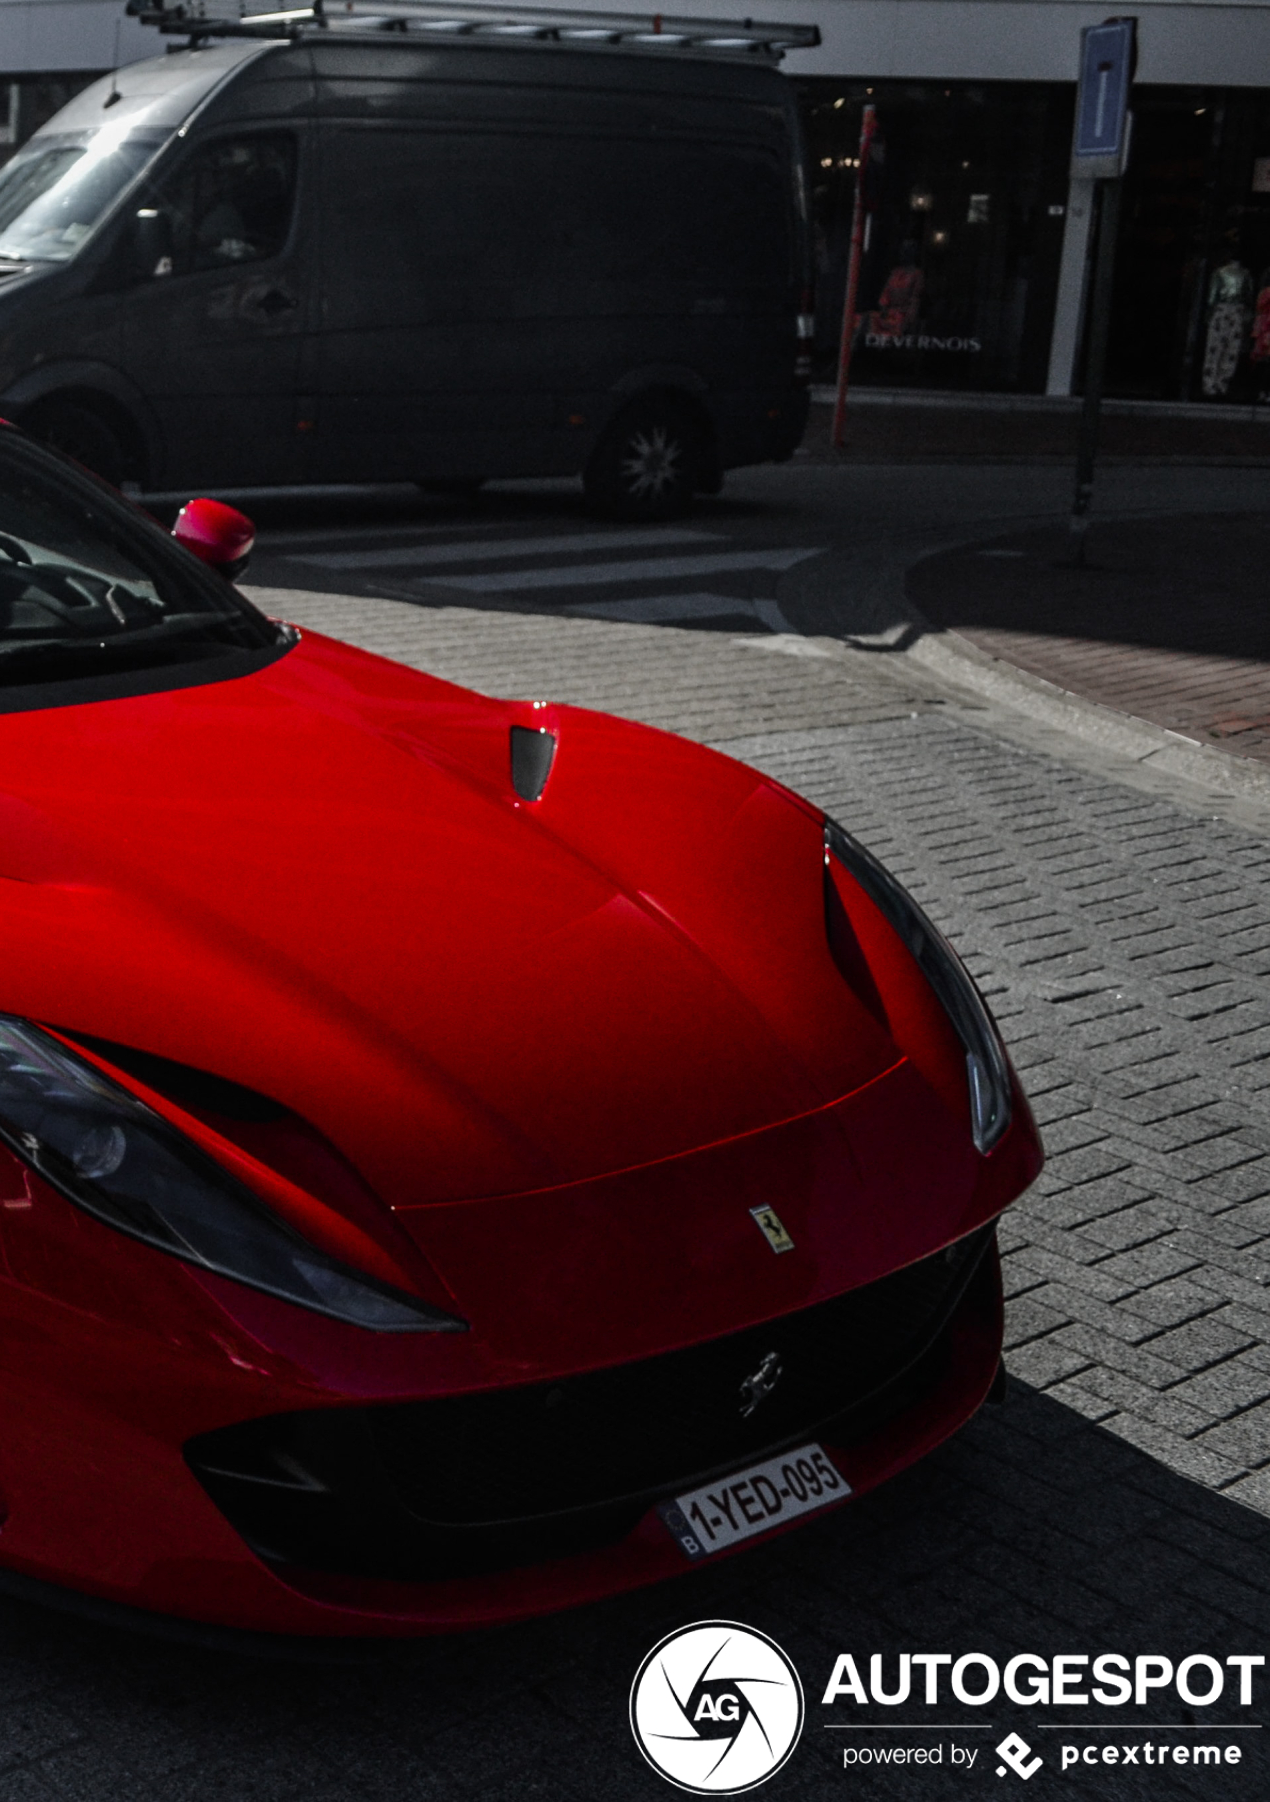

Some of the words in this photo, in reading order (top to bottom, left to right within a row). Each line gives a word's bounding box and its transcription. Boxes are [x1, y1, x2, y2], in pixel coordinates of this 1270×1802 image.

[864, 332, 982, 352] DEVERNOIS
[690, 1452, 839, 1541] 1-YED-095
[680, 1535, 699, 1555] B
